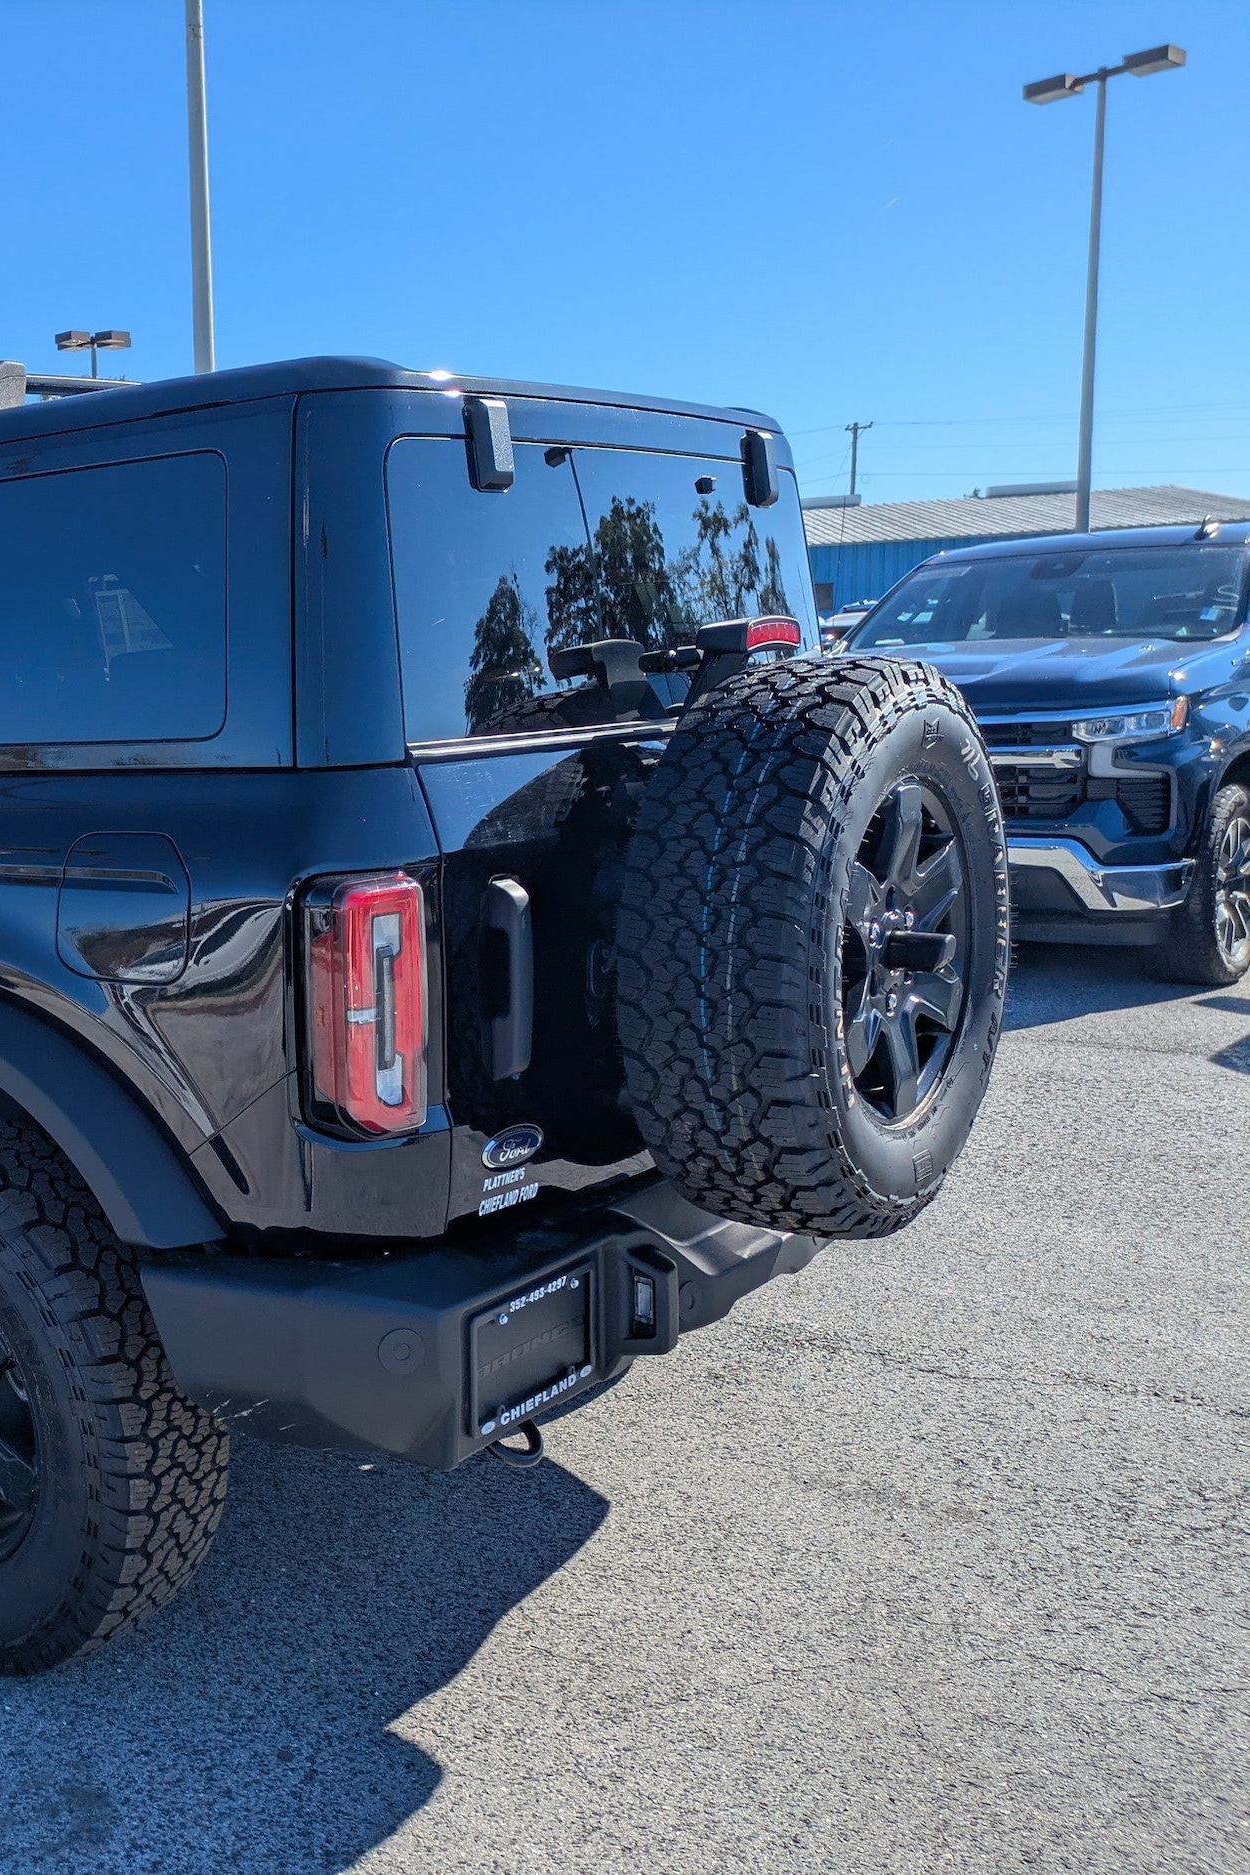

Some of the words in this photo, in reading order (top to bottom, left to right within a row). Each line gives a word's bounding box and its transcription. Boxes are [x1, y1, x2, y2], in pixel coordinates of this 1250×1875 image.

[499, 1136, 532, 1162] Ford
[478, 1188, 520, 1217] CHIEFLAND
[518, 1182, 539, 1203] FORD
[500, 1373, 577, 1426] CHIEFLAND
